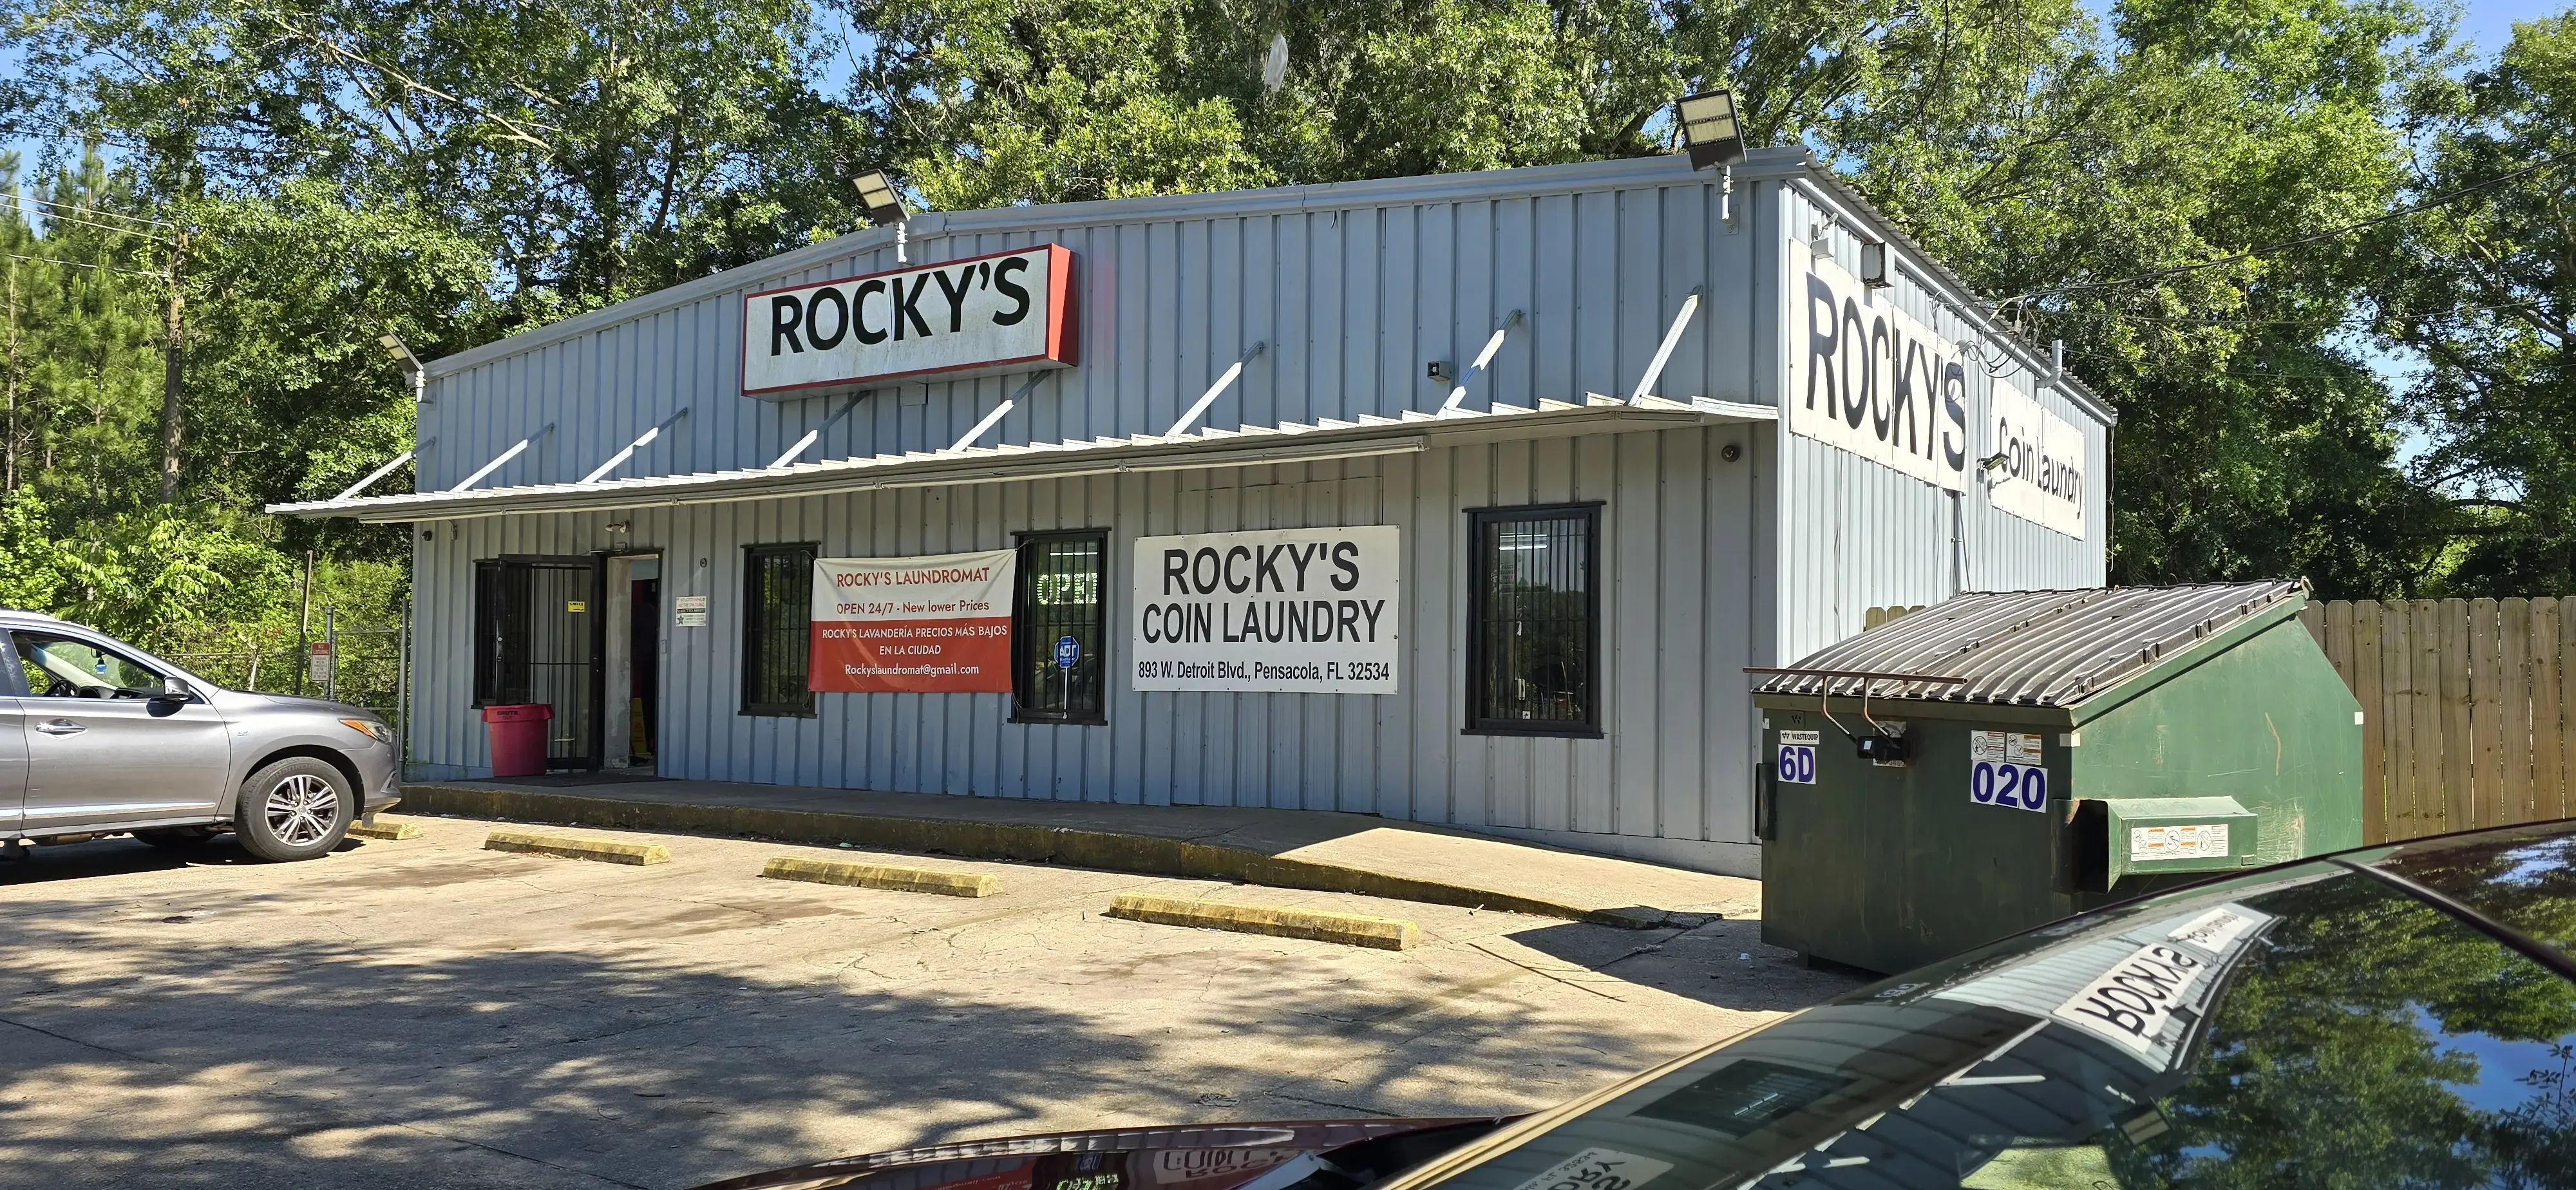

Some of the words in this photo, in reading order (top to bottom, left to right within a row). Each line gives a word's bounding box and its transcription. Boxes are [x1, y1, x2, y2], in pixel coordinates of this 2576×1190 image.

[771, 257, 1030, 356] ROCKY'S
[2036, 436, 2083, 520] Laundry
[837, 571, 891, 587] ROCKY'S
[896, 567, 990, 585] LAUNDROMAT
[1164, 541, 1359, 595] ROCKY'S
[837, 603, 865, 614] OPEN
[869, 602, 894, 616] 24/7
[903, 601, 925, 614] New
[928, 600, 956, 612] lower
[960, 599, 990, 611] Prices
[1142, 603, 1211, 644] COIN
[1224, 600, 1385, 643] LAUNDRY
[822, 628, 857, 639] ROCKY'S
[859, 625, 913, 638] LAVANDERÍA
[915, 627, 952, 638] PRECIOS
[955, 623, 975, 637] MÁS
[978, 625, 1007, 638] BAJOS
[879, 645, 892, 656] EN
[894, 645, 906, 655] LA
[907, 645, 941, 656] CIUDAD
[845, 663, 980, 678] Rockyslaundromat@gmail.com
[1139, 661, 1158, 679] 893
[1160, 661, 1174, 678] W.
[1177, 661, 1215, 679] Detroit
[1218, 661, 1251, 683] Blvd.,
[1255, 661, 1322, 683] Pensacola,
[1327, 661, 1344, 681] FL
[1348, 661, 1389, 681] 32534
[1779, 746, 1814, 782] 6D
[1973, 762, 2045, 810] 020
